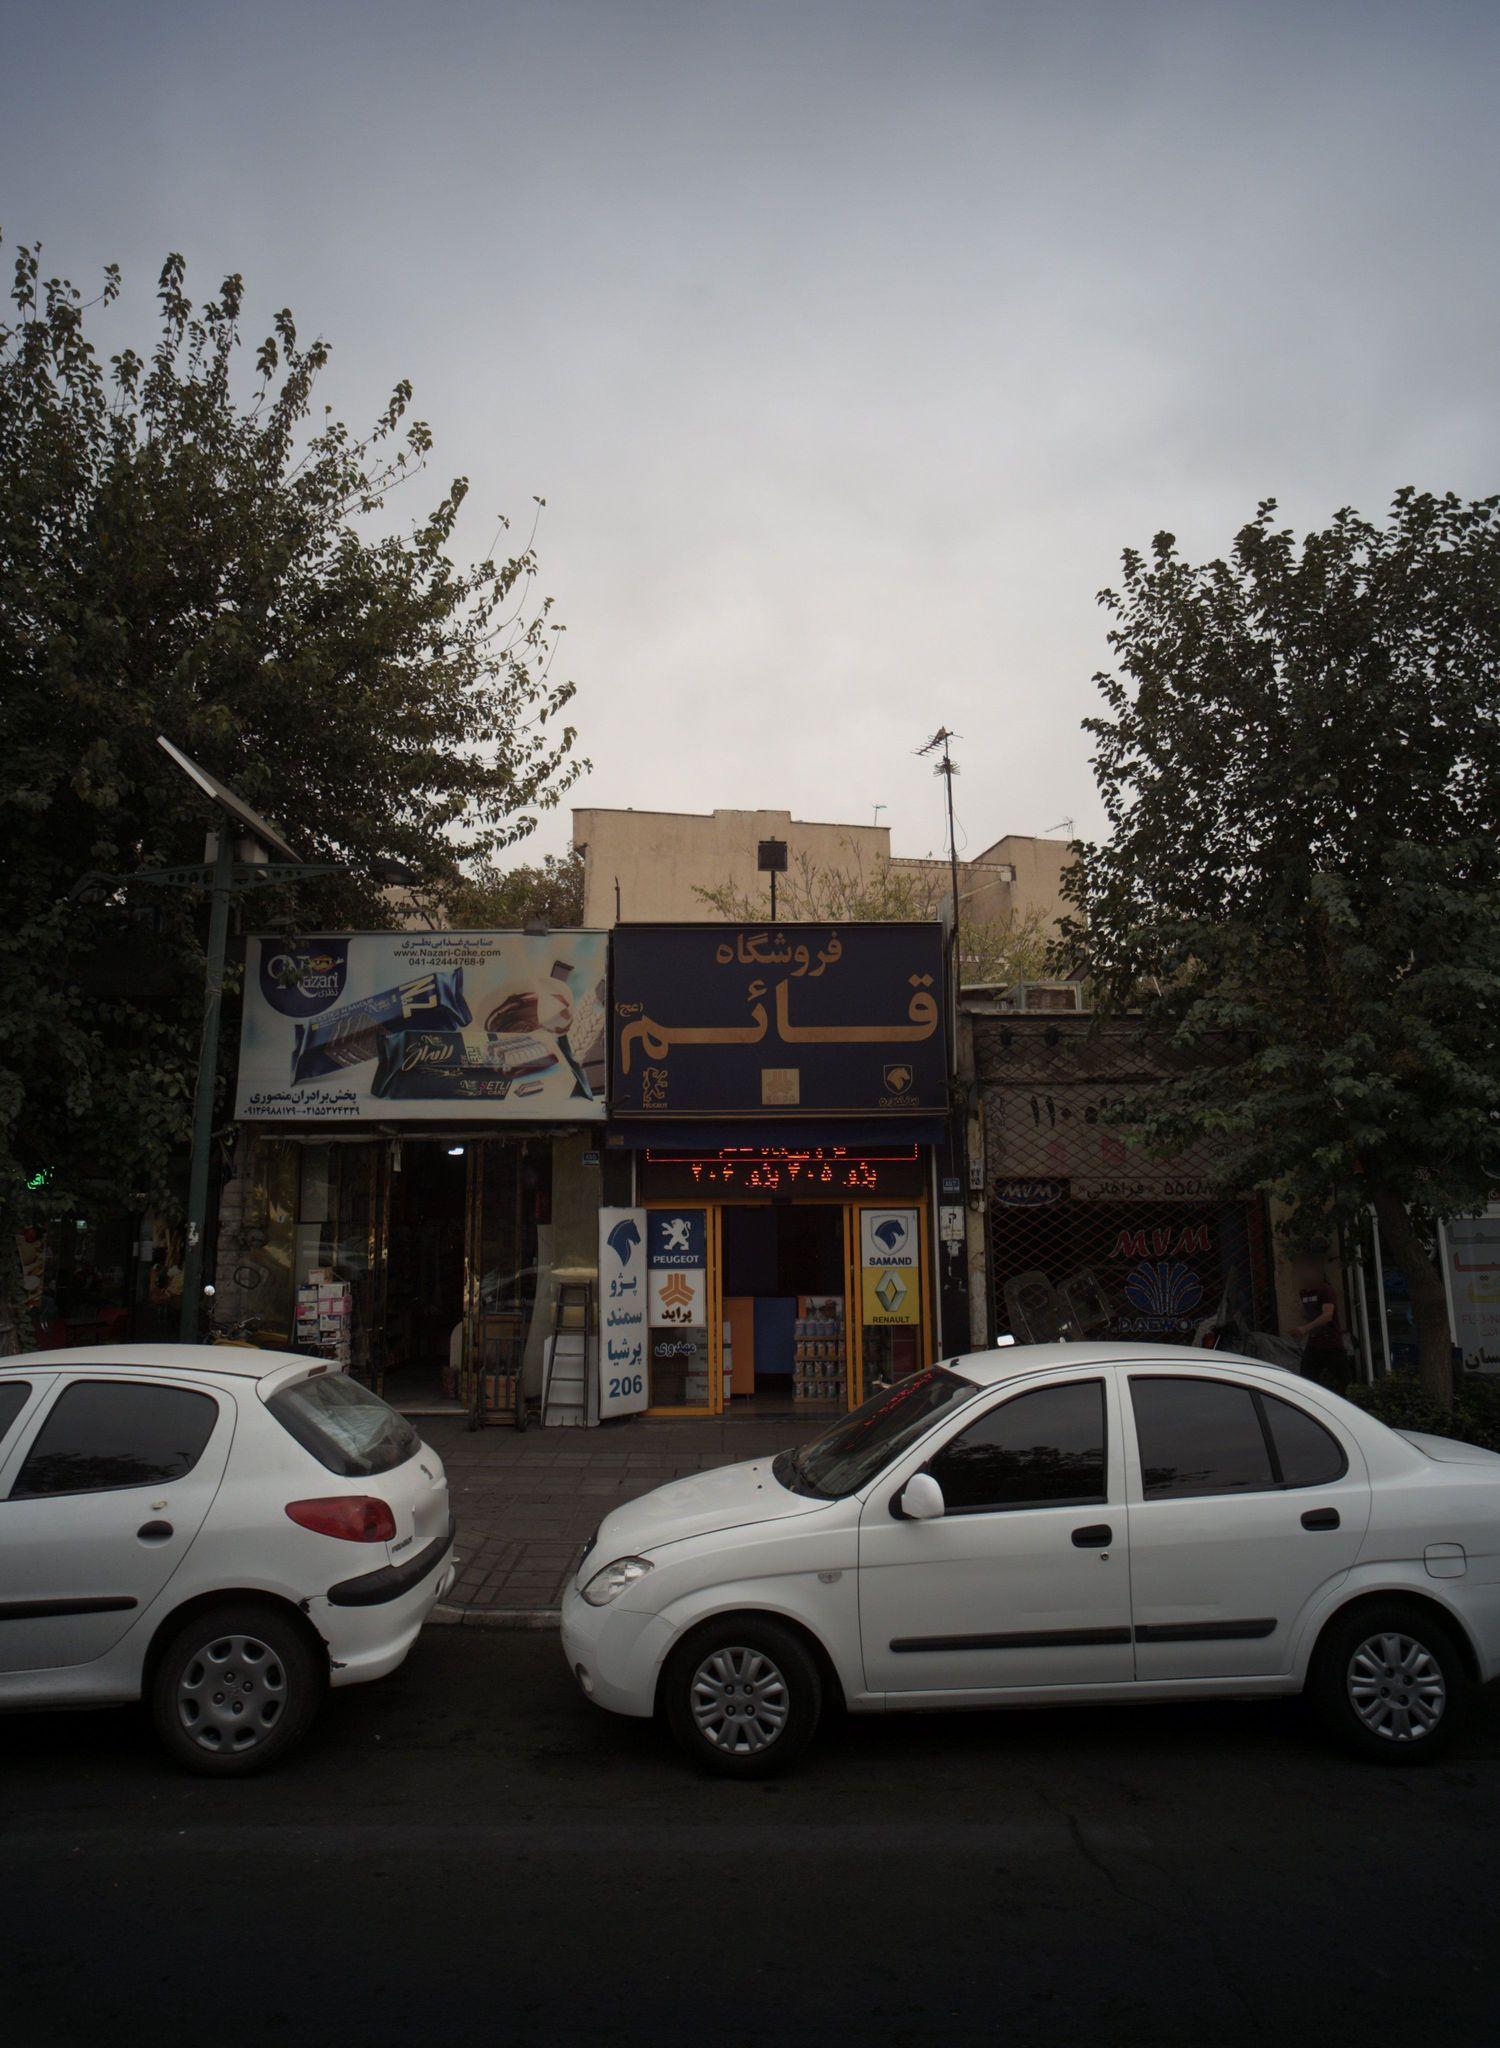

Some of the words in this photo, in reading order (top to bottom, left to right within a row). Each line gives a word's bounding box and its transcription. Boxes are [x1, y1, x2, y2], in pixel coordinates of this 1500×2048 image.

[394, 949, 500, 958] www.Nazari-Cake.com
[402, 937, 431, 949] نظری
[715, 931, 843, 976] فروشگاه
[620, 974, 939, 1075] قائم
[1108, 1225, 1211, 1258] MVM
[653, 1255, 700, 1264] PEUGEOT
[869, 1257, 912, 1266] SAMAND
[609, 1272, 637, 1297] پژو
[607, 1304, 642, 1326] سمند
[662, 1307, 692, 1323] پراید
[872, 1316, 910, 1324] RENAULT
[607, 1338, 642, 1365] پرشیا
[609, 1375, 642, 1398] 206
